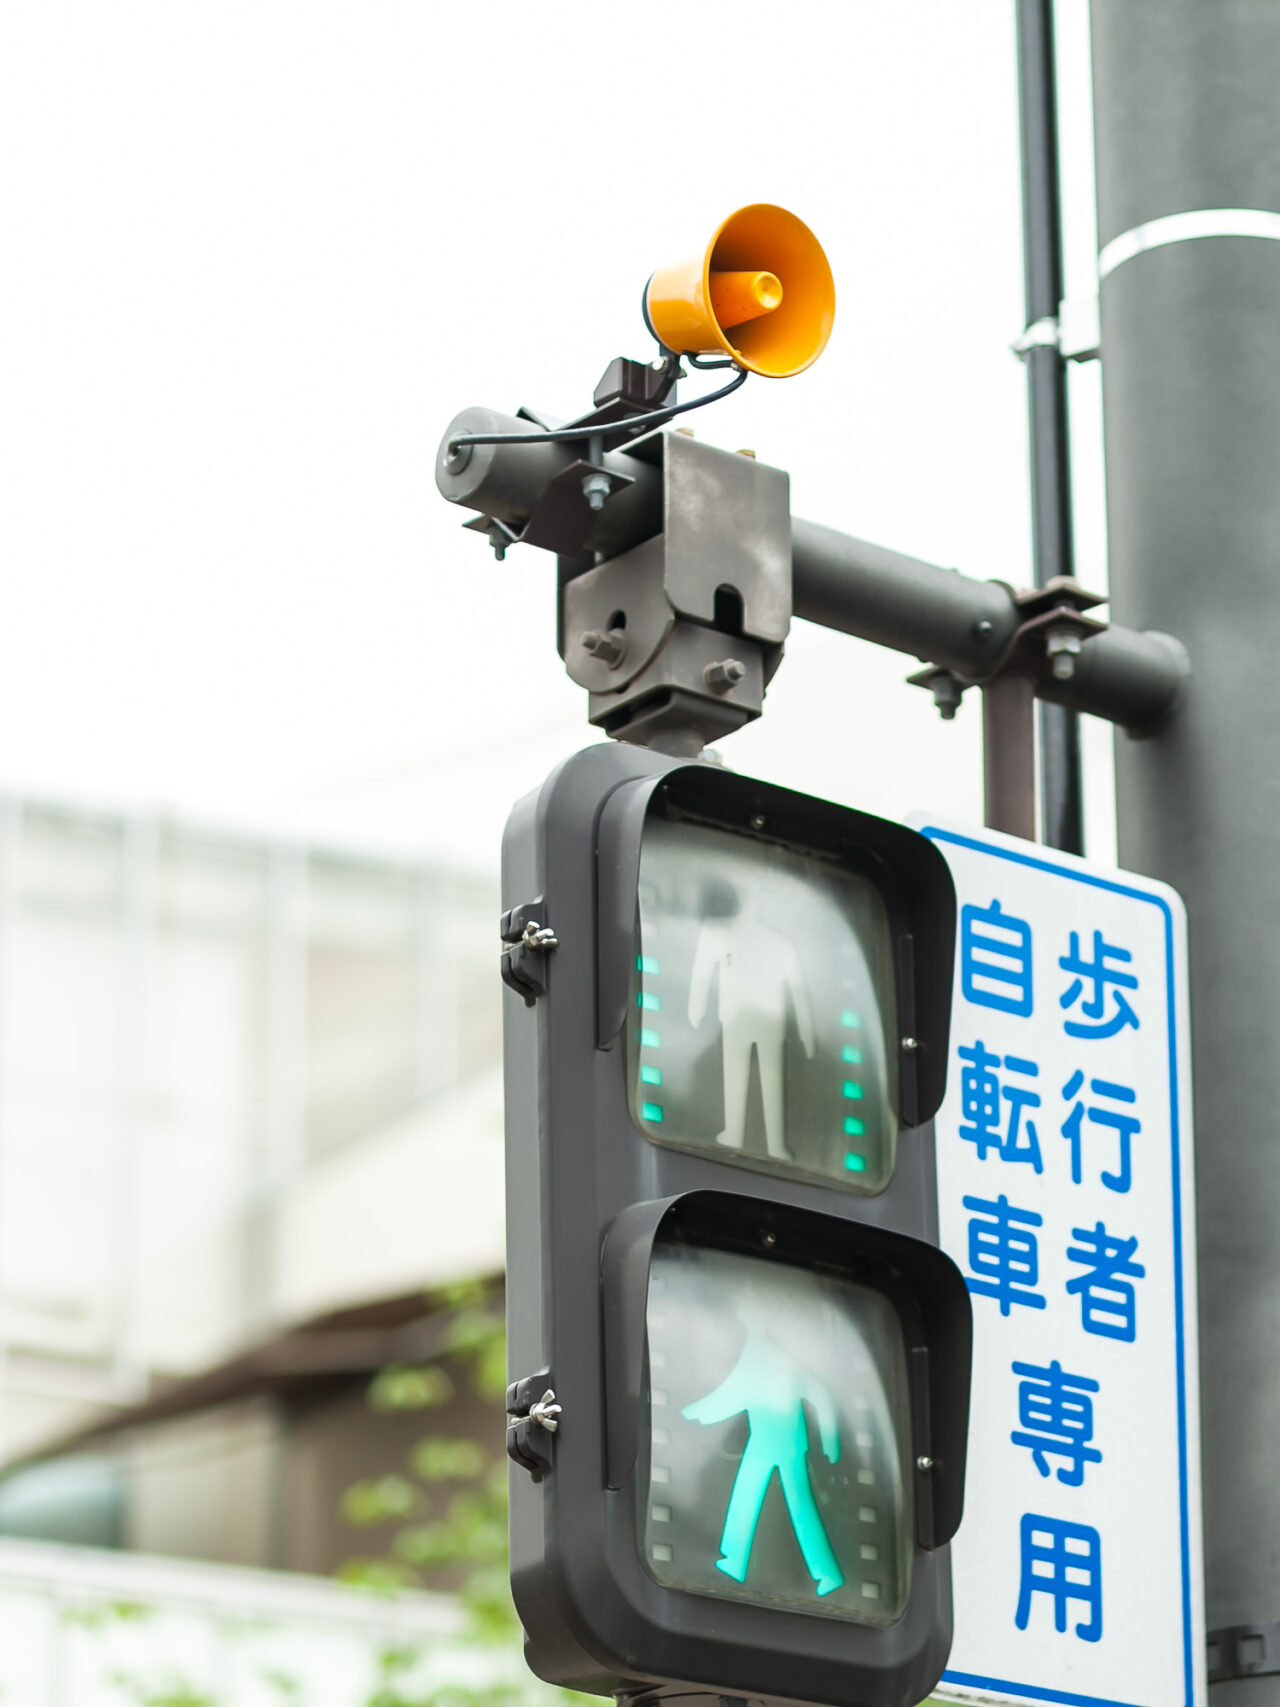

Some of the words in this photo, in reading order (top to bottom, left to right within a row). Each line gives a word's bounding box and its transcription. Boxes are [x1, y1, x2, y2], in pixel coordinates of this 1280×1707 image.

[957, 898, 1048, 1318] 自転車
[1057, 929, 1147, 1344] 歩行者
[1009, 1359, 1104, 1644] 専用
